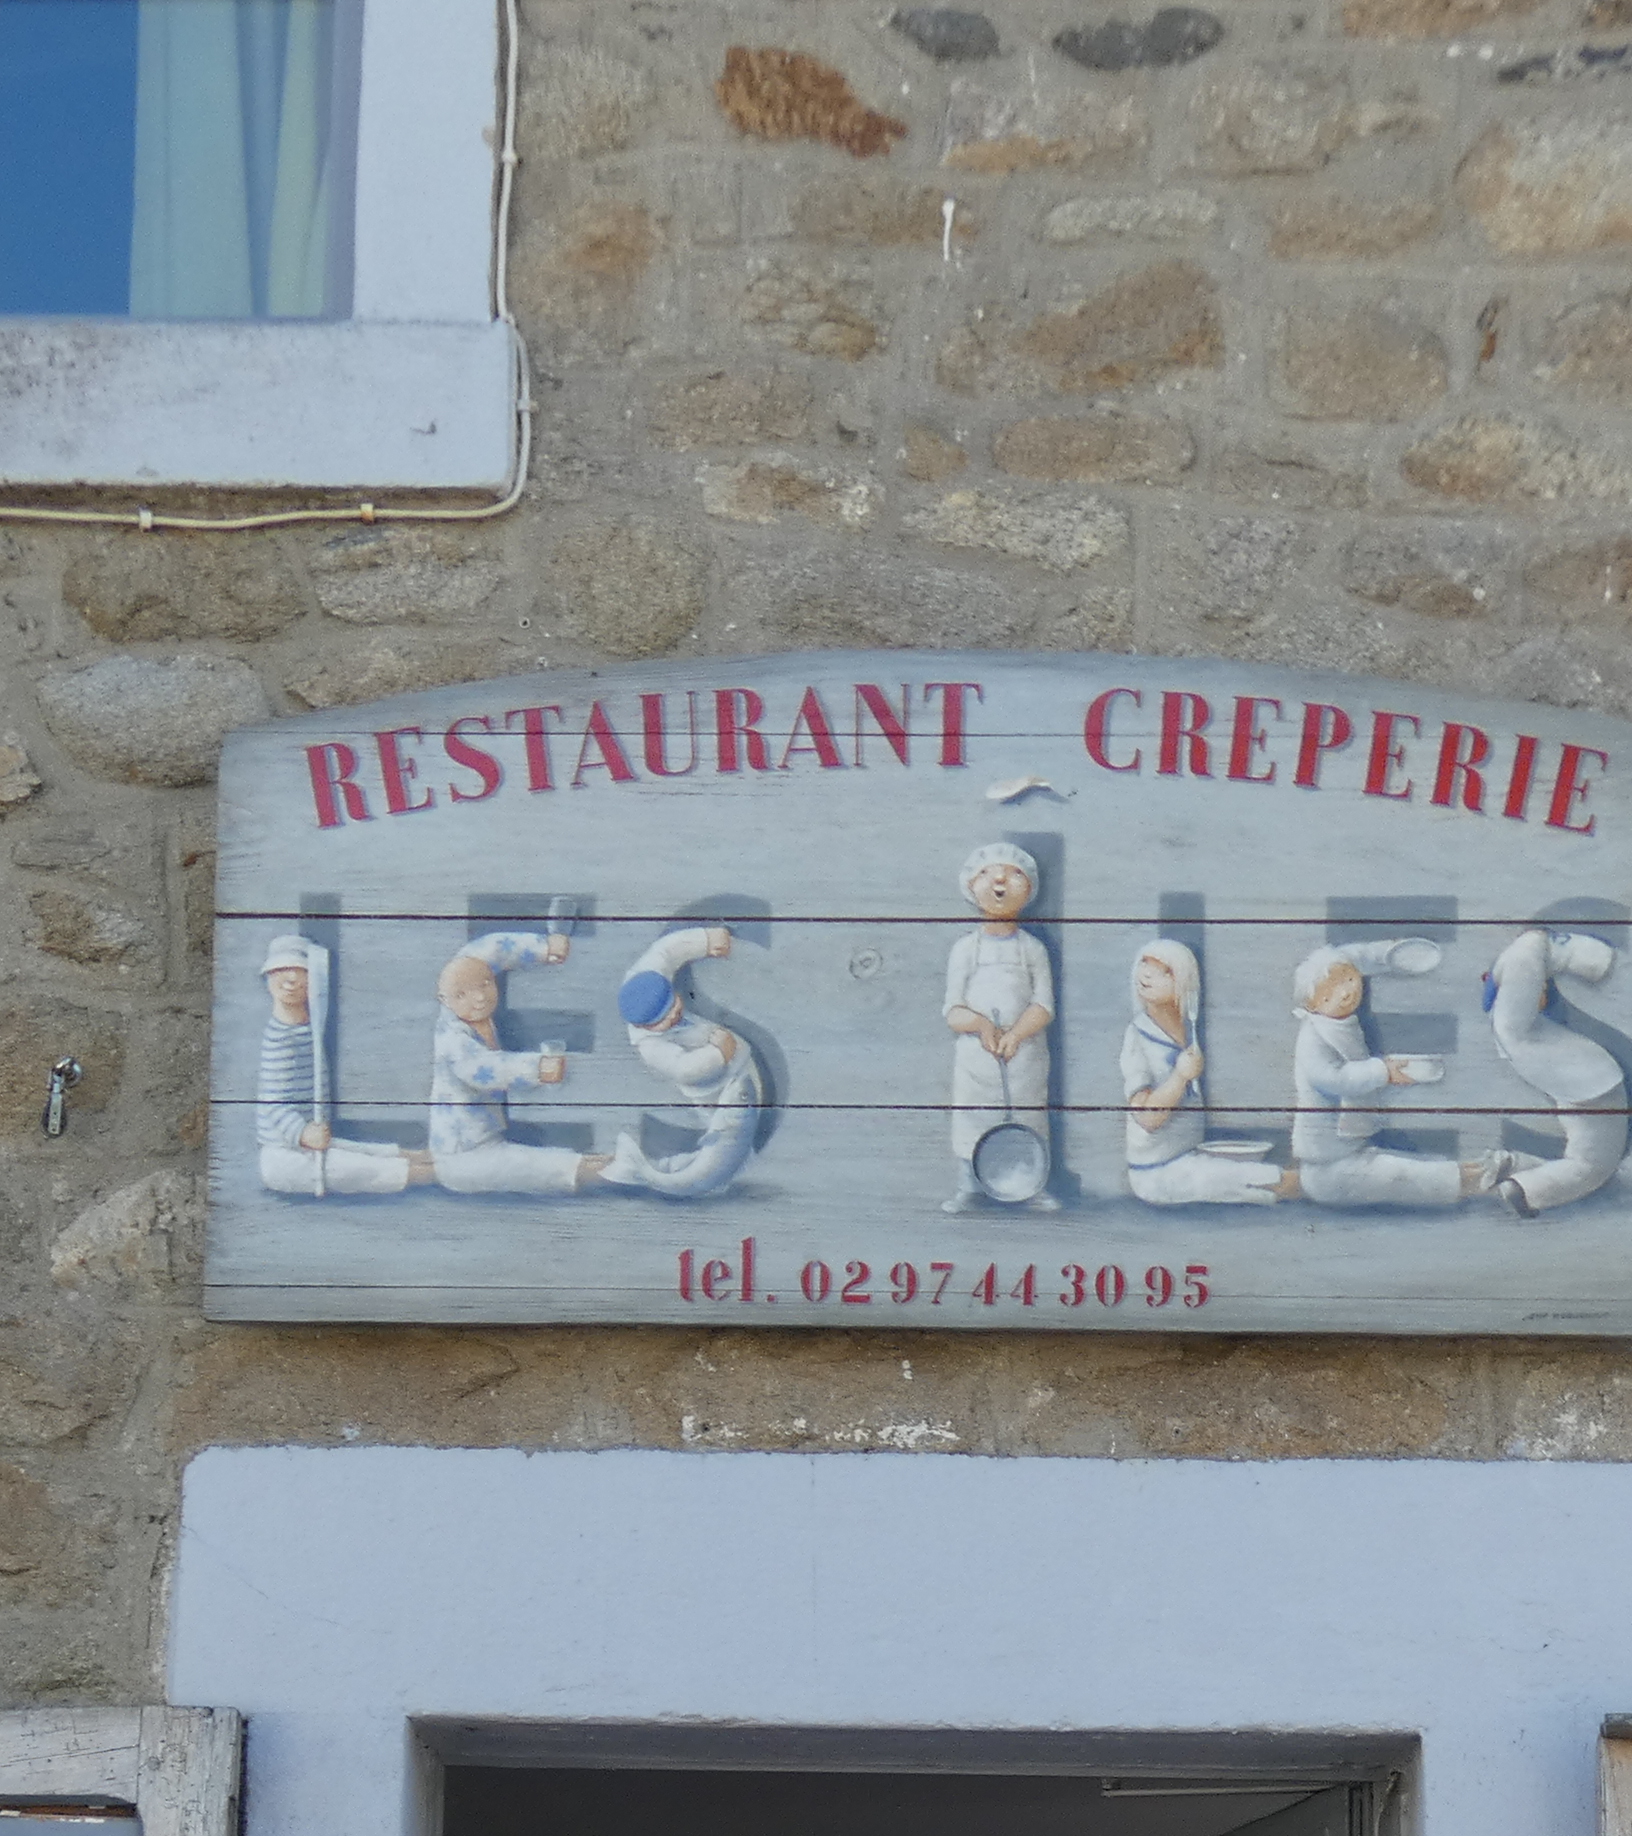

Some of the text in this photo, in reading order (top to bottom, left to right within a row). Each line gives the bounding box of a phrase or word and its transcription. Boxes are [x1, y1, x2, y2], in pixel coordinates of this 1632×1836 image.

[304, 681, 1611, 837] RESTAURANT CREPERIE
[256, 894, 768, 1200] LES
[677, 1236, 776, 1304] tel.
